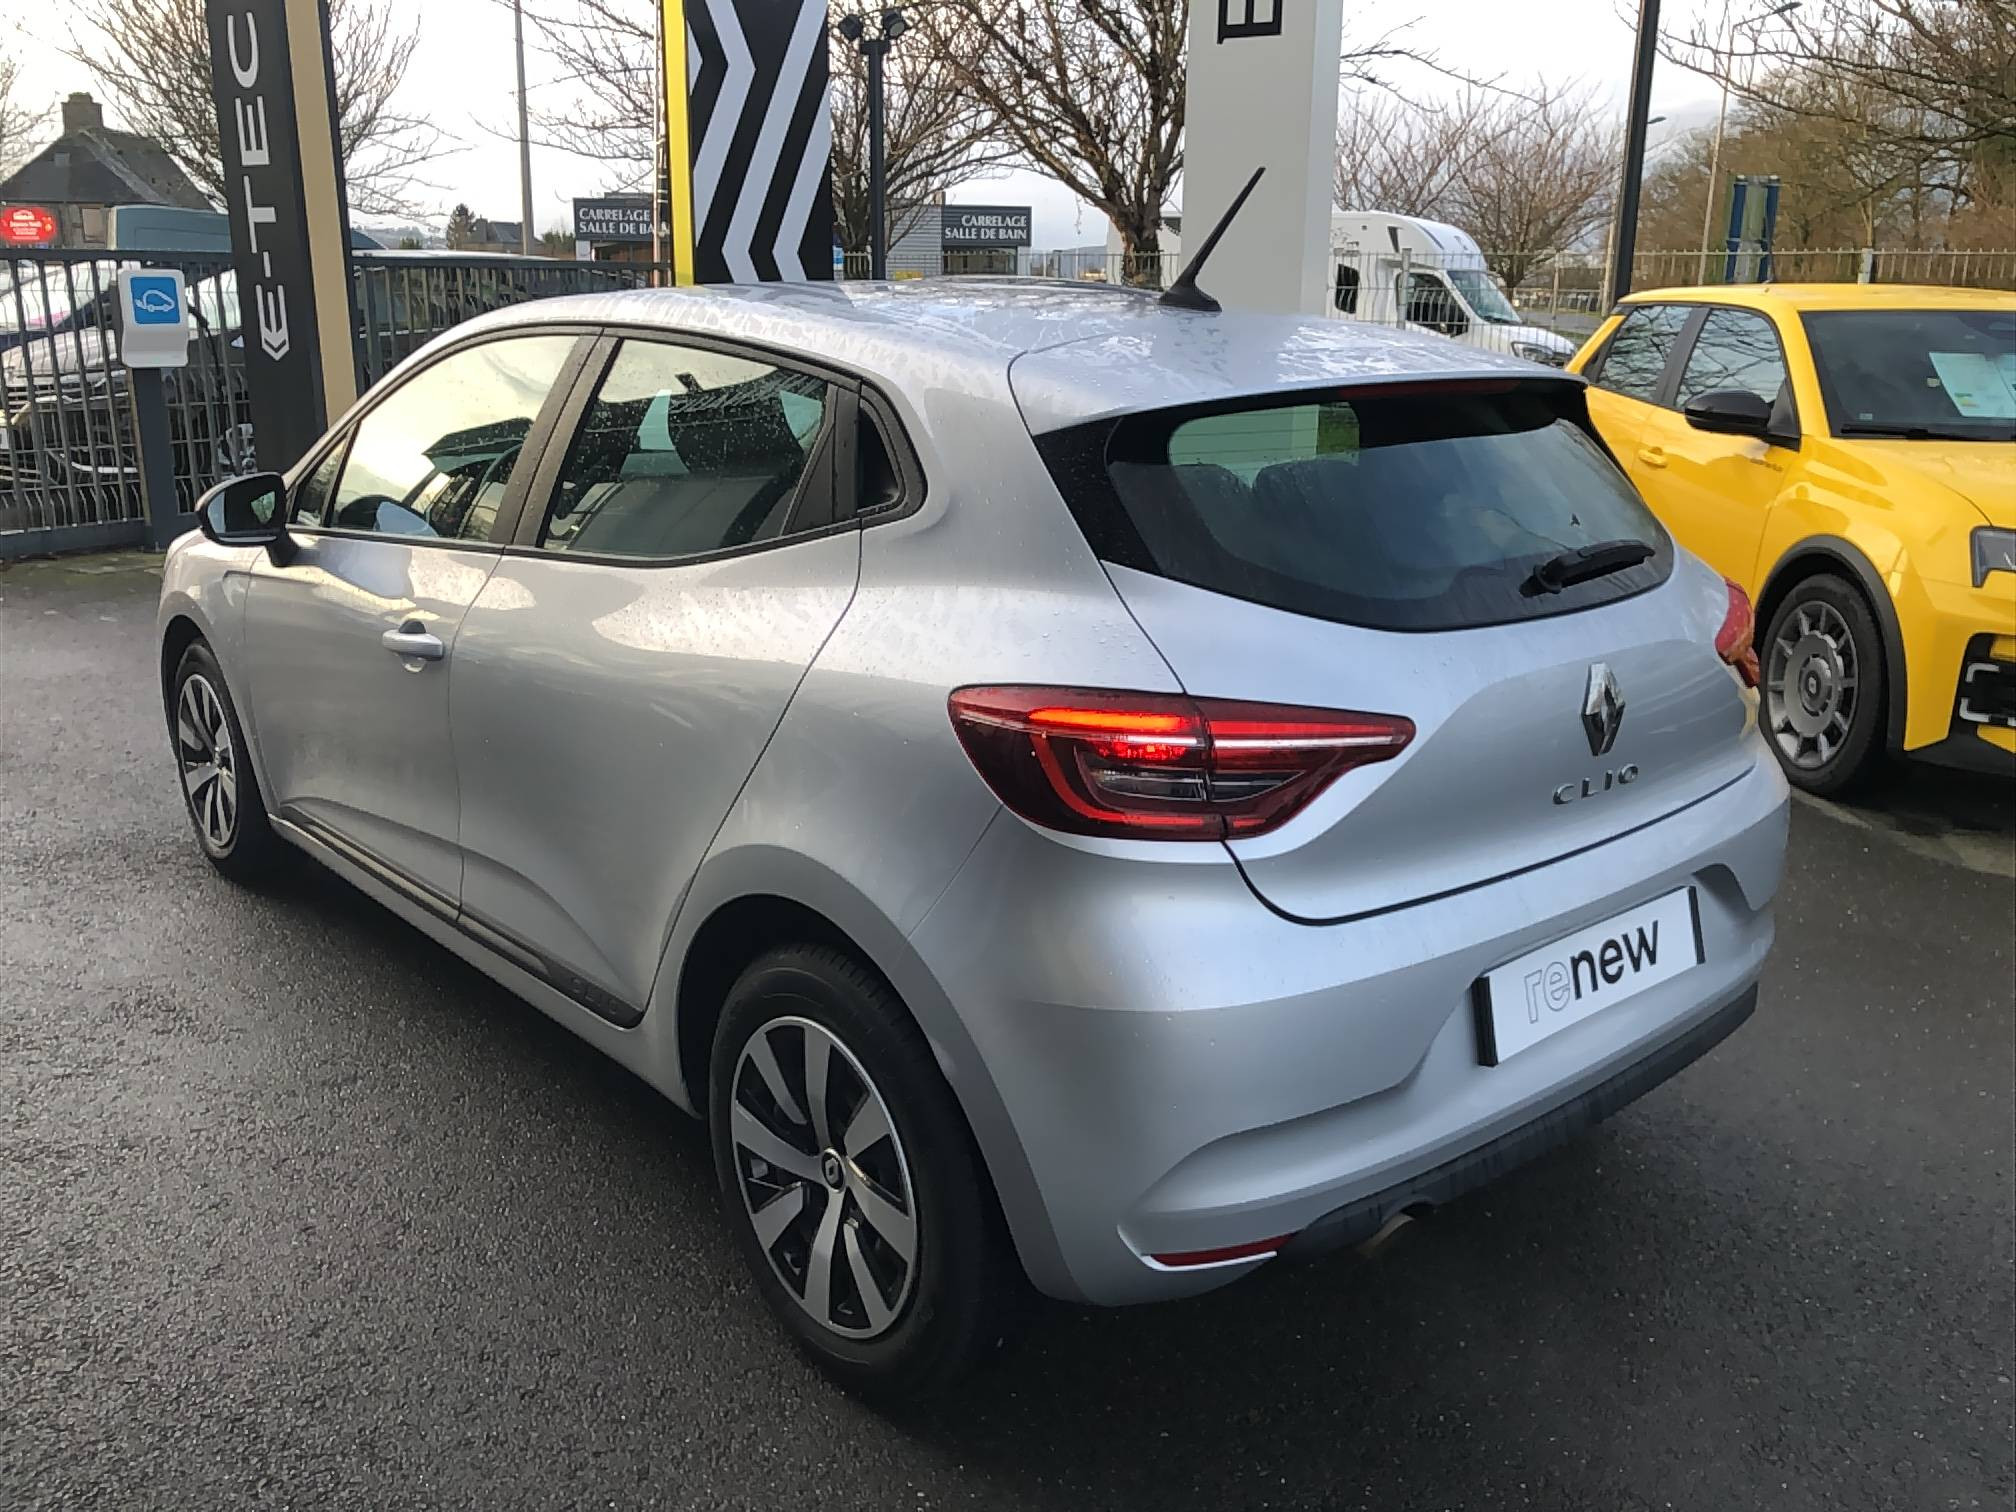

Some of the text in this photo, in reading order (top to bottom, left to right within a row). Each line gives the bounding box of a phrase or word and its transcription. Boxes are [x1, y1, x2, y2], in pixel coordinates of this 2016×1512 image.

[579, 207, 651, 221] CARRELAGE
[961, 214, 1027, 227] CARRELAGE
[579, 221, 616, 233] SALLE
[620, 222, 637, 234] DE
[944, 227, 1027, 239] SALLE DE BAIN
[1552, 763, 1639, 805] CLIO
[1523, 919, 1659, 1024] renew
